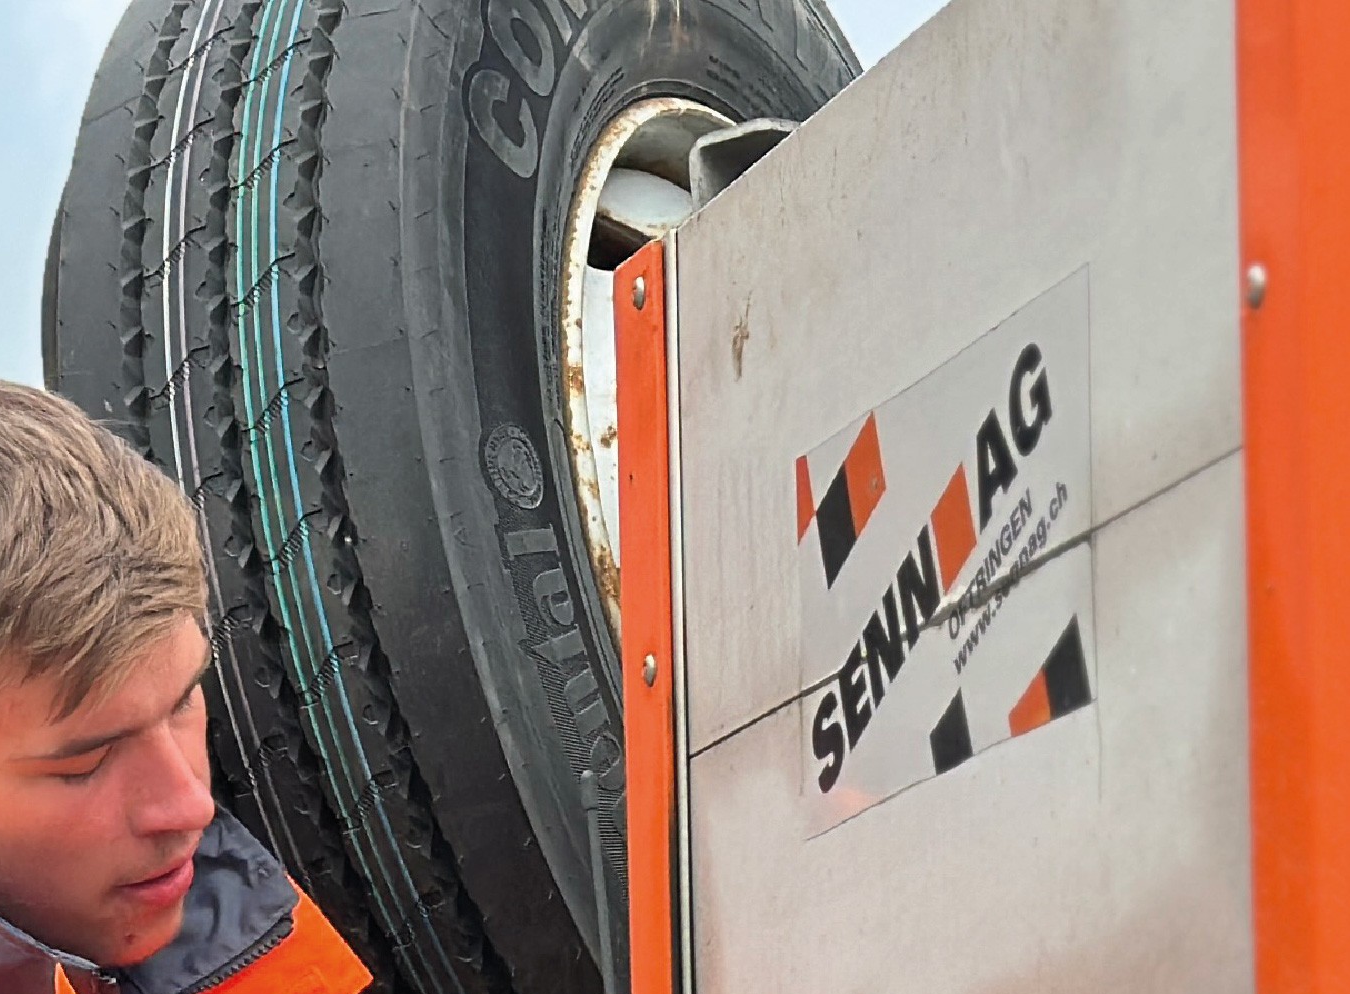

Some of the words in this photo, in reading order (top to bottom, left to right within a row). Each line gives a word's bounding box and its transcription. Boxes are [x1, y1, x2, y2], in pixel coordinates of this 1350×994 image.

[505, 522, 626, 838] ental
[812, 523, 941, 795] SENN
[976, 343, 1052, 535] AG
[949, 486, 1033, 640] OFTRINGEN
